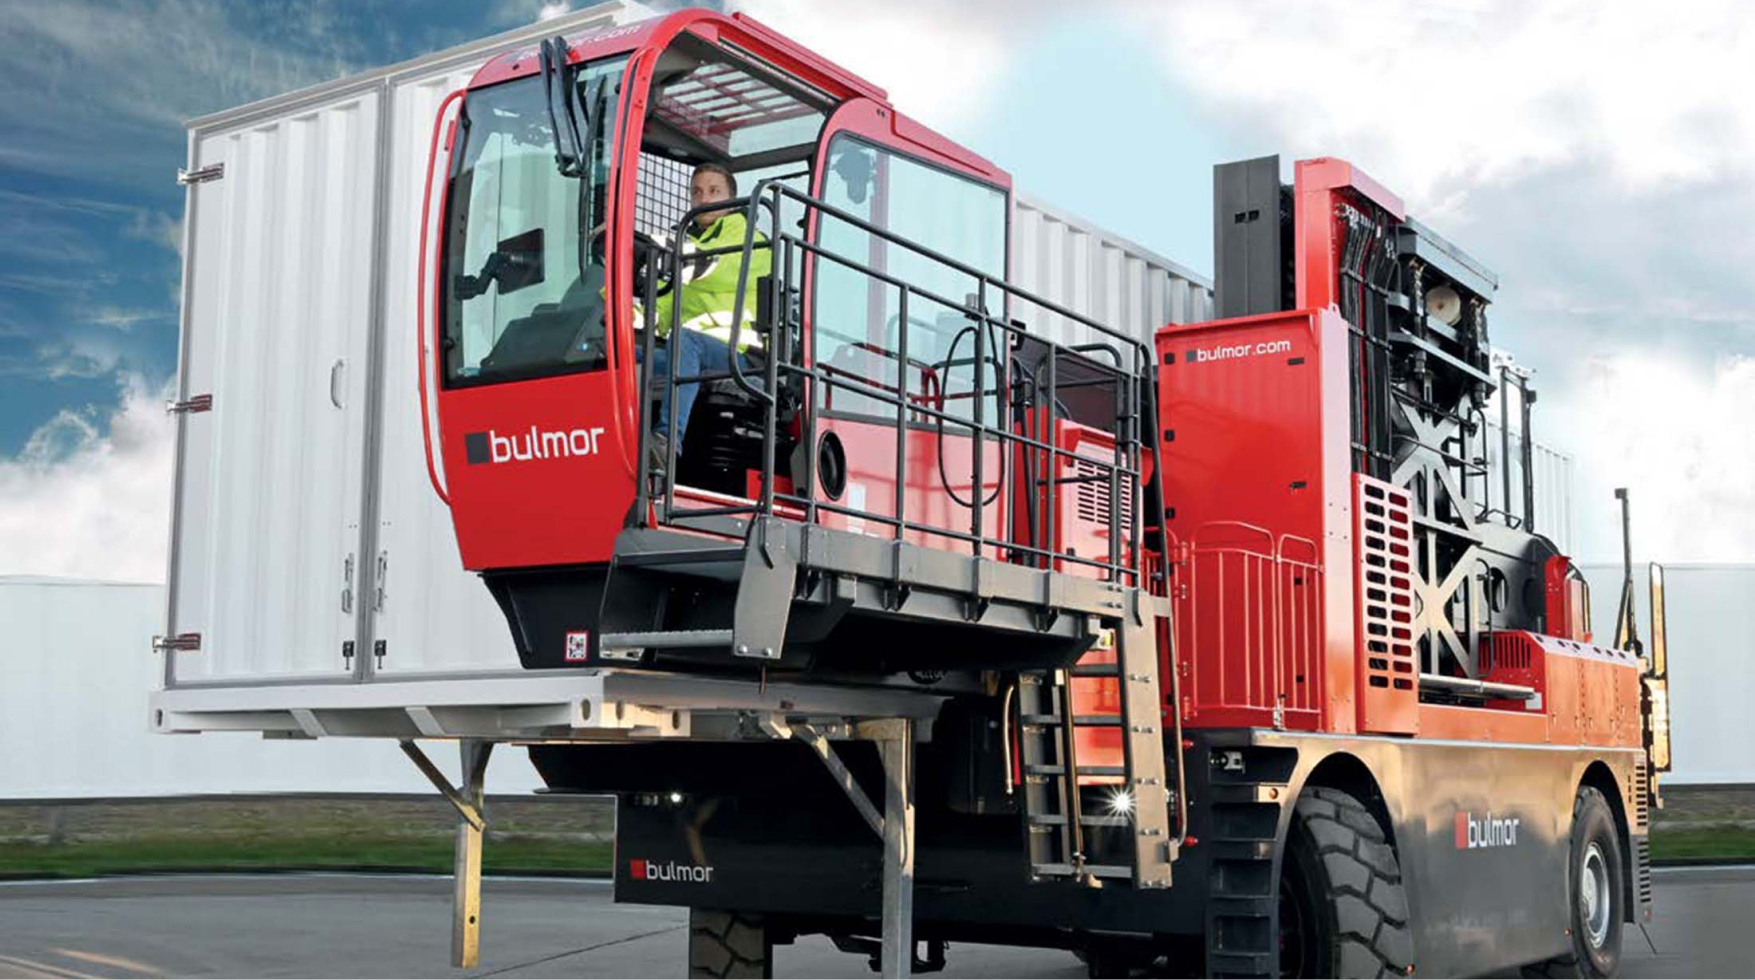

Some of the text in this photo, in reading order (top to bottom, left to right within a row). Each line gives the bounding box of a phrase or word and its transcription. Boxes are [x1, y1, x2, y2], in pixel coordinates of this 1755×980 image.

[1197, 340, 1291, 362] bulmor.com
[489, 425, 605, 464] bulmor
[1467, 811, 1519, 849] bulmor
[645, 860, 714, 882] bulmor
